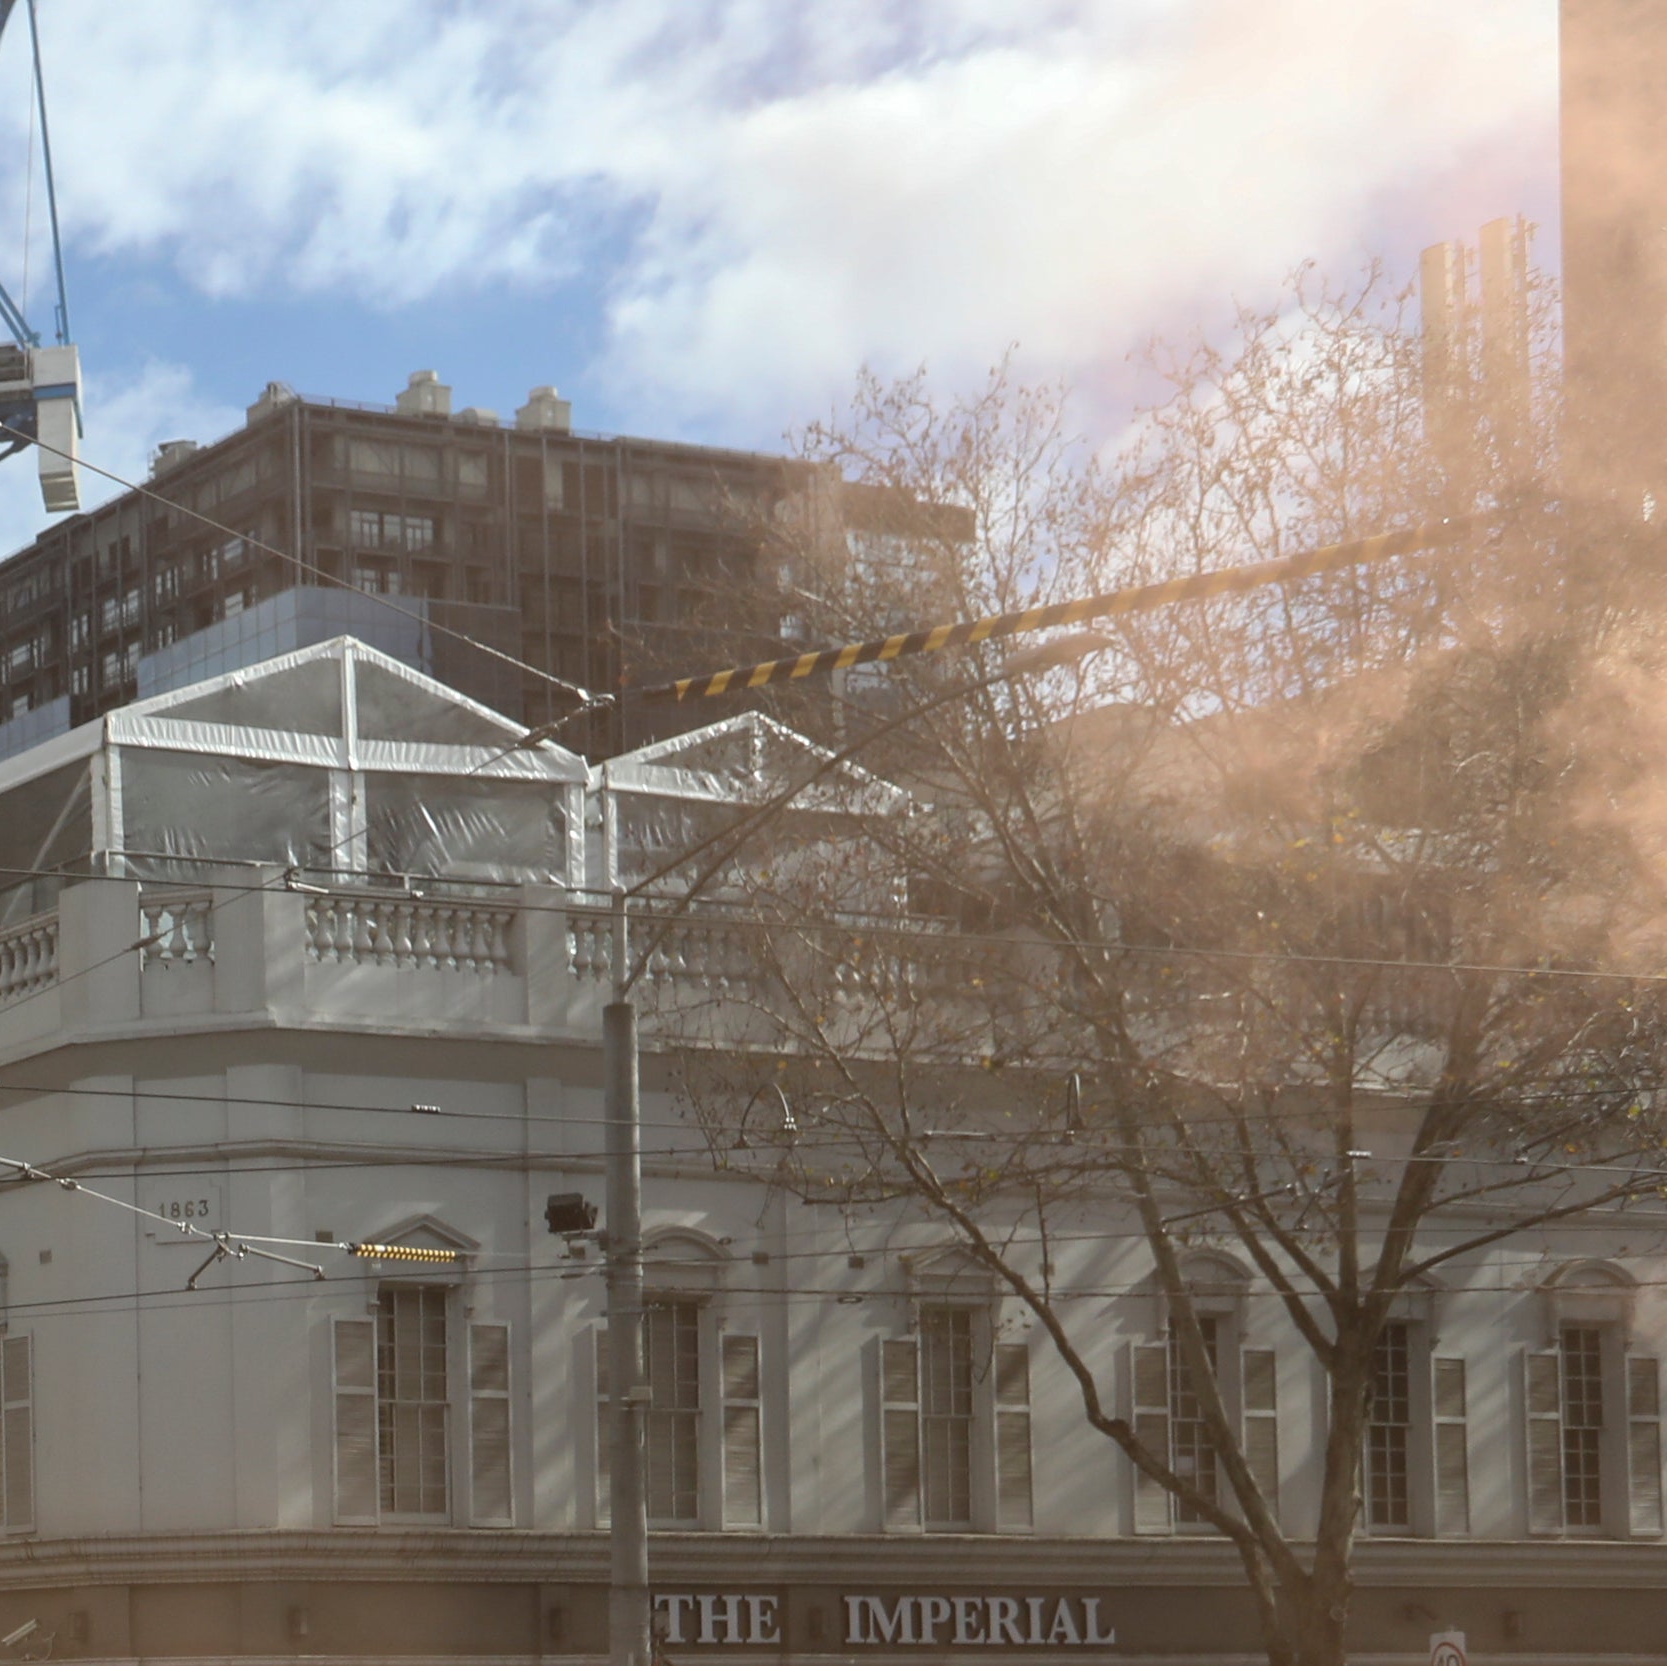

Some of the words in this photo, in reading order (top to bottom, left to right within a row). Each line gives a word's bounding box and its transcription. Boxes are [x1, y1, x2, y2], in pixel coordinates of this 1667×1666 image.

[158, 1199, 209, 1218] 1863
[654, 1594, 781, 1645] THE
[844, 1596, 1116, 1645] IMPERIAL
